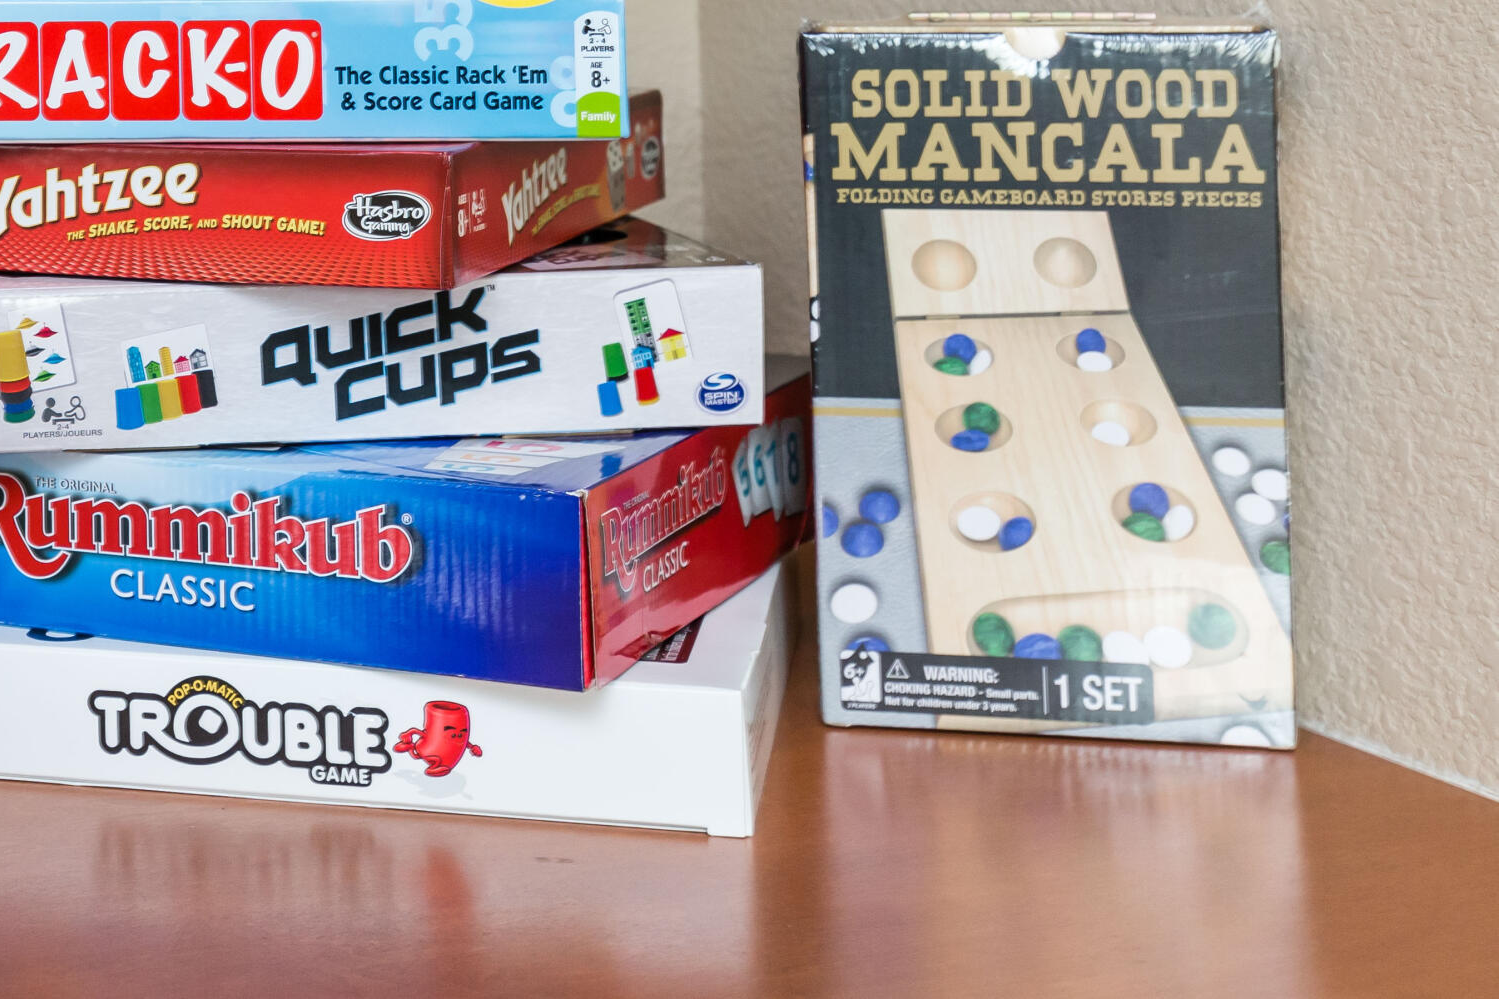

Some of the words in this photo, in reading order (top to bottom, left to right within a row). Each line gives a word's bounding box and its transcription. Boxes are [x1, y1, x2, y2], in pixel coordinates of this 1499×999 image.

[580, 45, 615, 53] PLAYERS
[334, 66, 372, 85] The
[379, 65, 449, 85] Classic
[455, 65, 506, 85] Rack
[590, 61, 603, 69] AGE
[590, 70, 611, 88] 8+
[340, 93, 356, 111] &
[363, 91, 422, 111] Score
[430, 91, 476, 111] Card
[483, 91, 544, 111] Game
[851, 68, 1032, 119] SOLID
[1051, 68, 1239, 119] WOOD
[580, 111, 617, 124] Family
[830, 122, 1266, 184] MANCALA
[501, 147, 569, 247] Yahtzee
[836, 188, 935, 205] FOLDING
[940, 189, 1085, 206] GAMEBOARD
[1091, 191, 1175, 208] STORES
[1181, 192, 1262, 208] PIECES
[347, 196, 424, 222] Hasbro
[67, 229, 85, 241] THE
[88, 219, 139, 238] SHAKE,
[143, 215, 193, 232] SCORE,
[197, 218, 218, 229] AND
[222, 214, 273, 231] SHOUT
[277, 217, 326, 236] GAME!
[360, 215, 411, 236] Gaming
[260, 286, 488, 386] QUICK
[334, 329, 541, 421] CUPS
[704, 391, 739, 402] SPIN
[704, 398, 739, 406] MASTER
[23, 429, 103, 439] PLAYERS/JOUEURS
[35, 475, 57, 489] THE
[60, 478, 117, 494] ORIGINAL
[601, 446, 726, 592] Rummikub
[643, 541, 690, 592] CLASSIC
[109, 568, 255, 612] CLASSIC
[843, 663, 865, 680] 6+
[923, 665, 999, 684] WARNING:
[167, 679, 243, 709] POP-O-MATIC
[884, 682, 931, 695] CHOKING
[932, 684, 977, 697] HAZARD
[986, 688, 1012, 699] Small
[1054, 674, 1069, 709] 1
[1082, 675, 1144, 712] SET
[884, 696, 900, 706] Not
[902, 696, 915, 706] for
[916, 698, 953, 709] children
[954, 701, 980, 710] under
[982, 701, 989, 711] 3
[93, 692, 390, 768] TROUBLE
[311, 765, 371, 785] GAME
